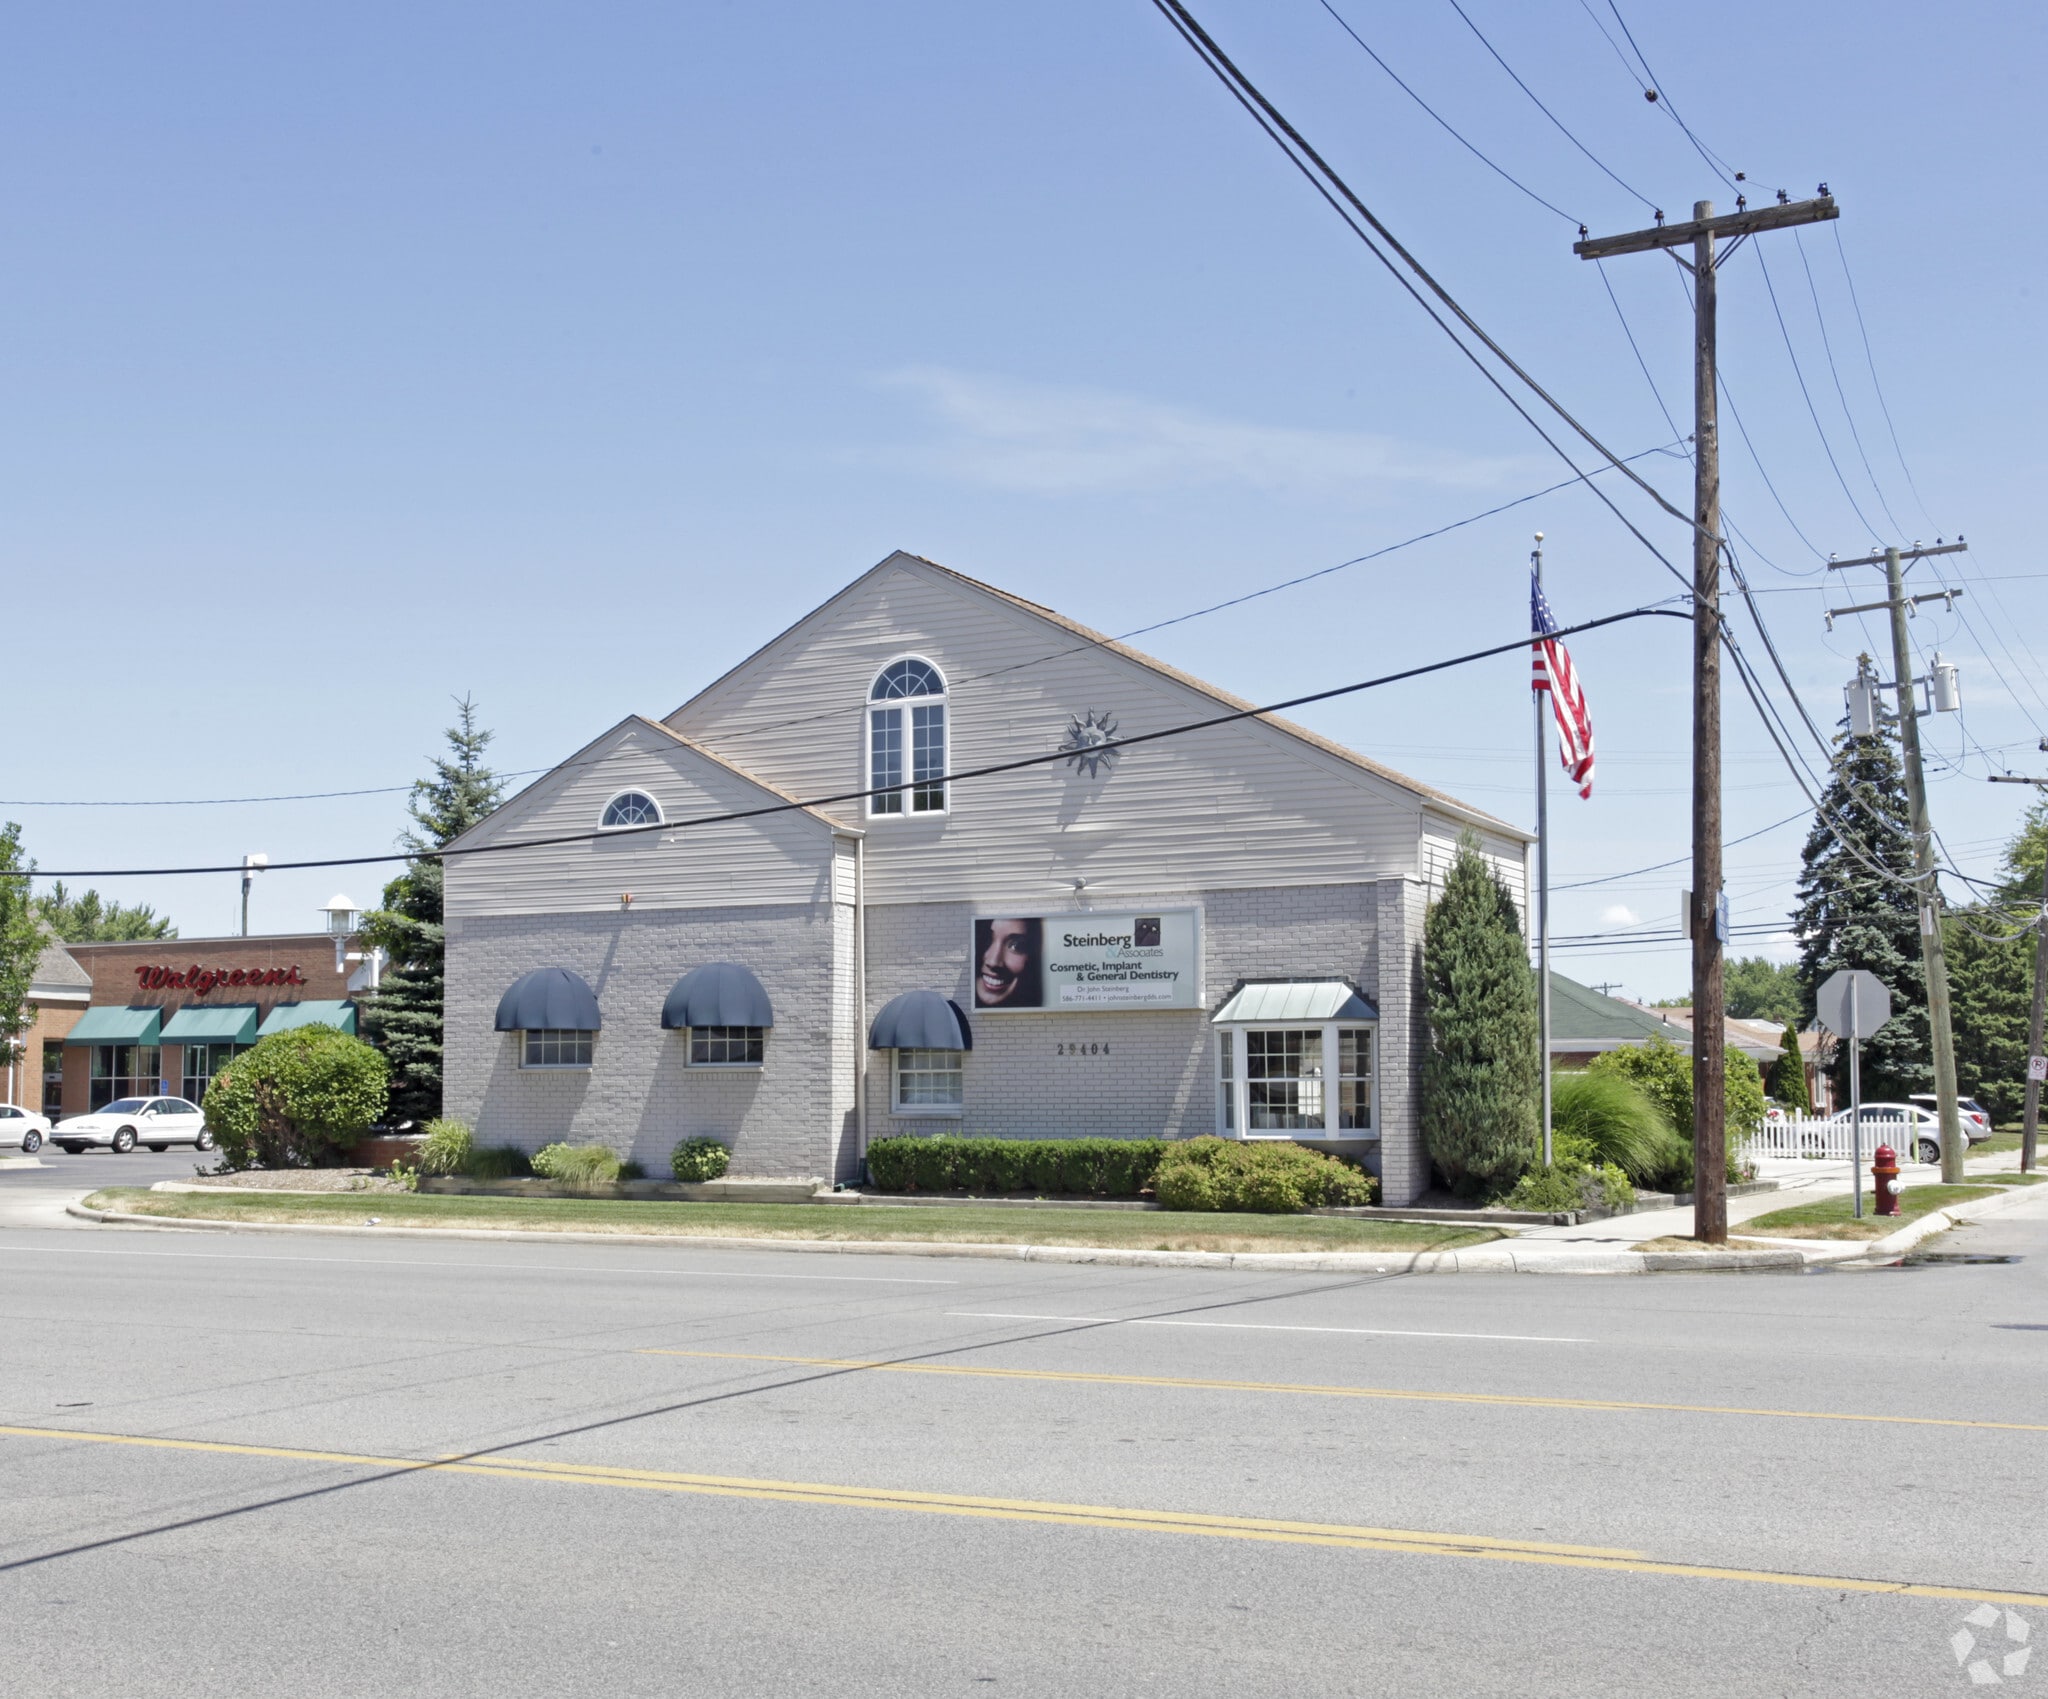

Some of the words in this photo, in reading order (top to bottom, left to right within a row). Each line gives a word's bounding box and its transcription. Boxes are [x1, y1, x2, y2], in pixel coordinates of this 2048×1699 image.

[1063, 933, 1132, 949] Steinberg
[1050, 962, 1100, 972] Cosmetic,
[1102, 961, 1142, 973] Implant
[134, 964, 305, 997] Walgreens
[1076, 972, 1084, 981] &
[1087, 971, 1127, 981] General
[1130, 970, 1179, 982] Dentistry
[1102, 985, 1129, 993] Steinberg
[1057, 1042, 1110, 1056] 29404
